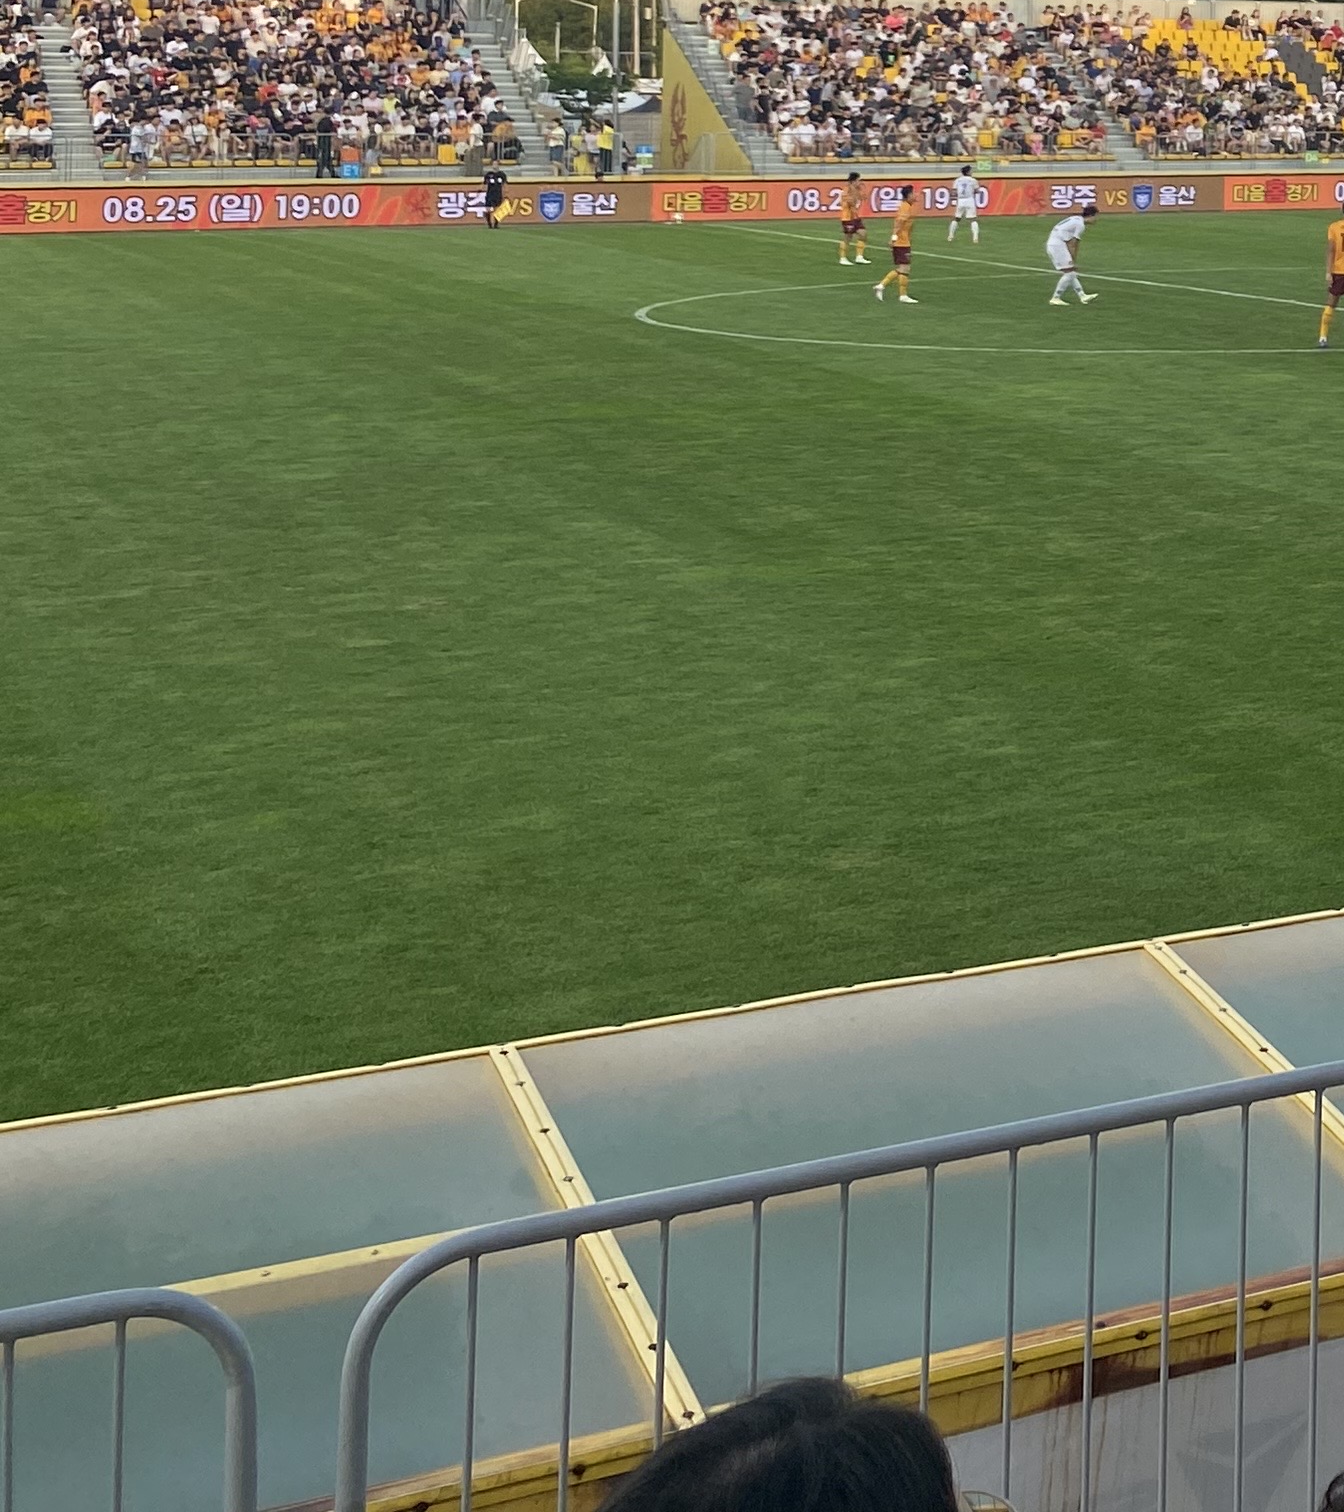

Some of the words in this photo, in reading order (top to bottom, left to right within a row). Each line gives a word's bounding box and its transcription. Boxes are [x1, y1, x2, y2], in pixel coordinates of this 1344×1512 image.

[343, 164, 360, 177] E1
[103, 195, 198, 223] 08.25
[209, 193, 264, 223] (일)
[275, 193, 361, 220] 19:00
[572, 192, 618, 216] 울산
[787, 188, 850, 213] 08.2
[1051, 184, 1097, 209] 광주
[1104, 189, 1129, 207] VS
[1158, 185, 1197, 207] 울산
